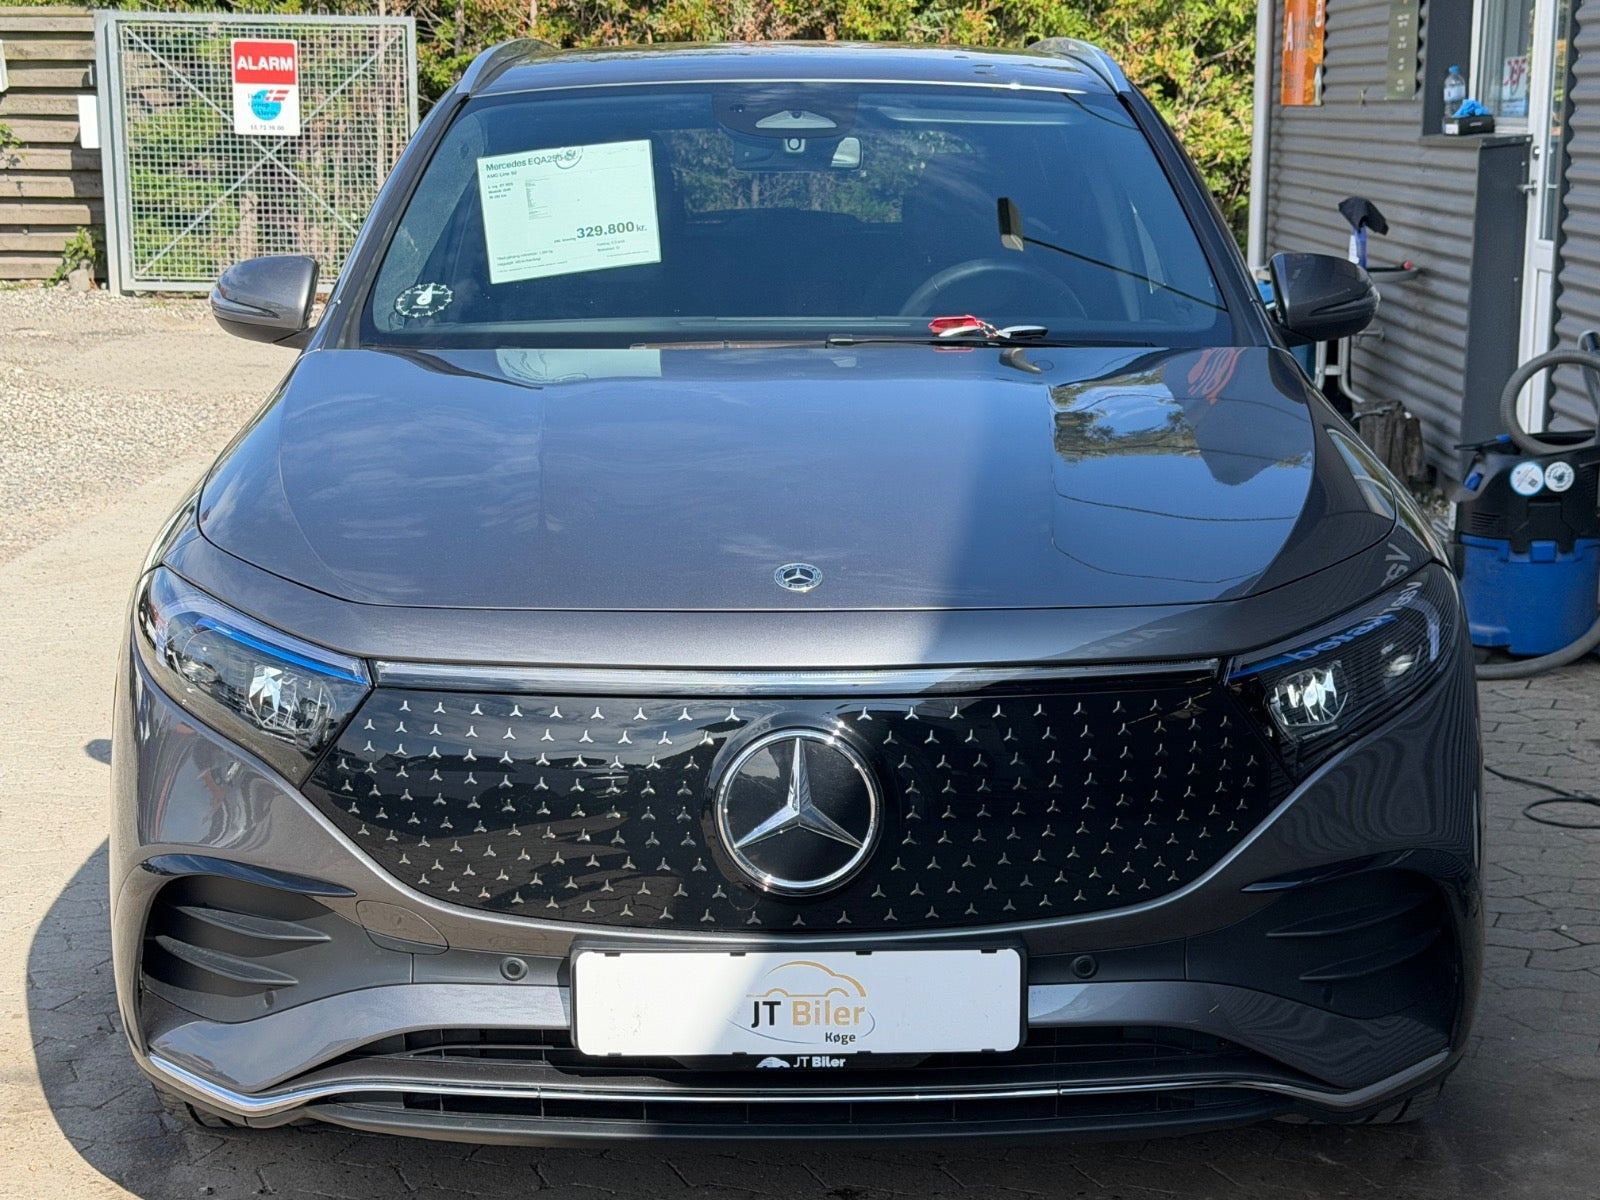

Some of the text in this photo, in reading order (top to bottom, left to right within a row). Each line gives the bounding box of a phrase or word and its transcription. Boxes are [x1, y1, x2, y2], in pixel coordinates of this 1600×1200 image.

[237, 55, 293, 72] ALARM
[485, 158, 527, 172] Mercedes
[576, 221, 647, 239] 329.800 kr.
[751, 999, 865, 1028] JT Biler
[825, 1032, 856, 1045] Køge
[793, 1056, 846, 1068] JT Biler
